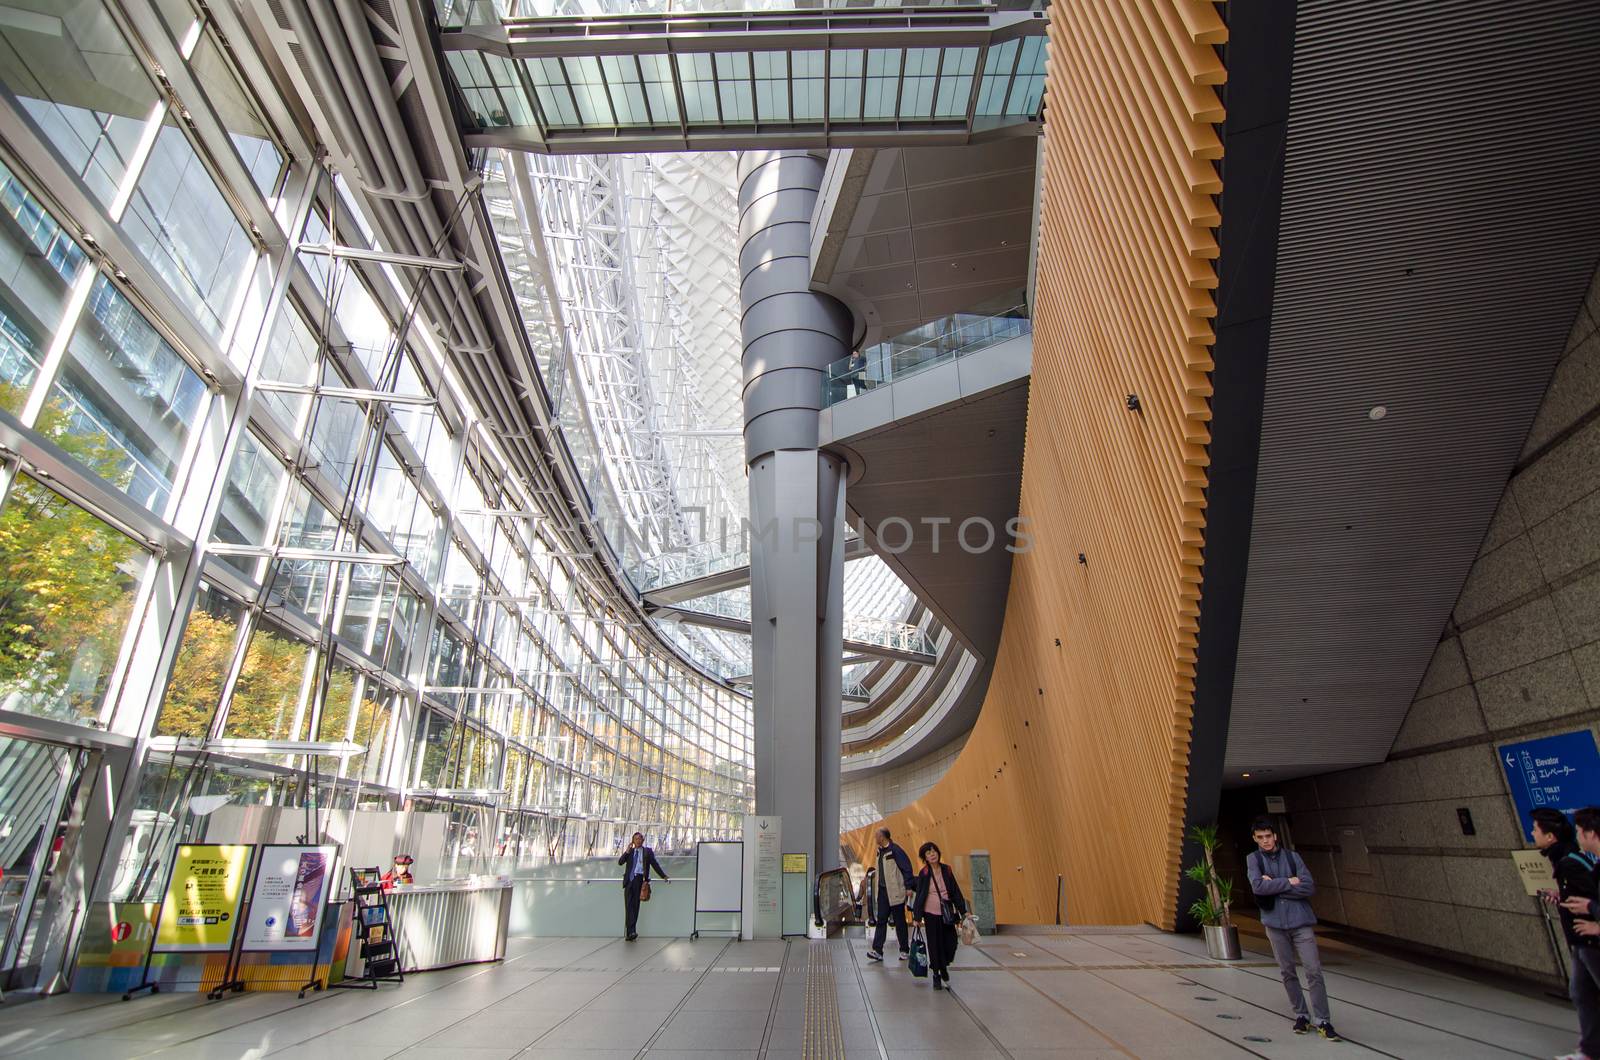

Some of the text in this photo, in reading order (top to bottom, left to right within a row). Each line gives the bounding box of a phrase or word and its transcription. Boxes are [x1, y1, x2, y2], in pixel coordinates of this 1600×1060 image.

[1539, 766, 1576, 778] エレベーター
[1543, 786, 1560, 794] TOILET
